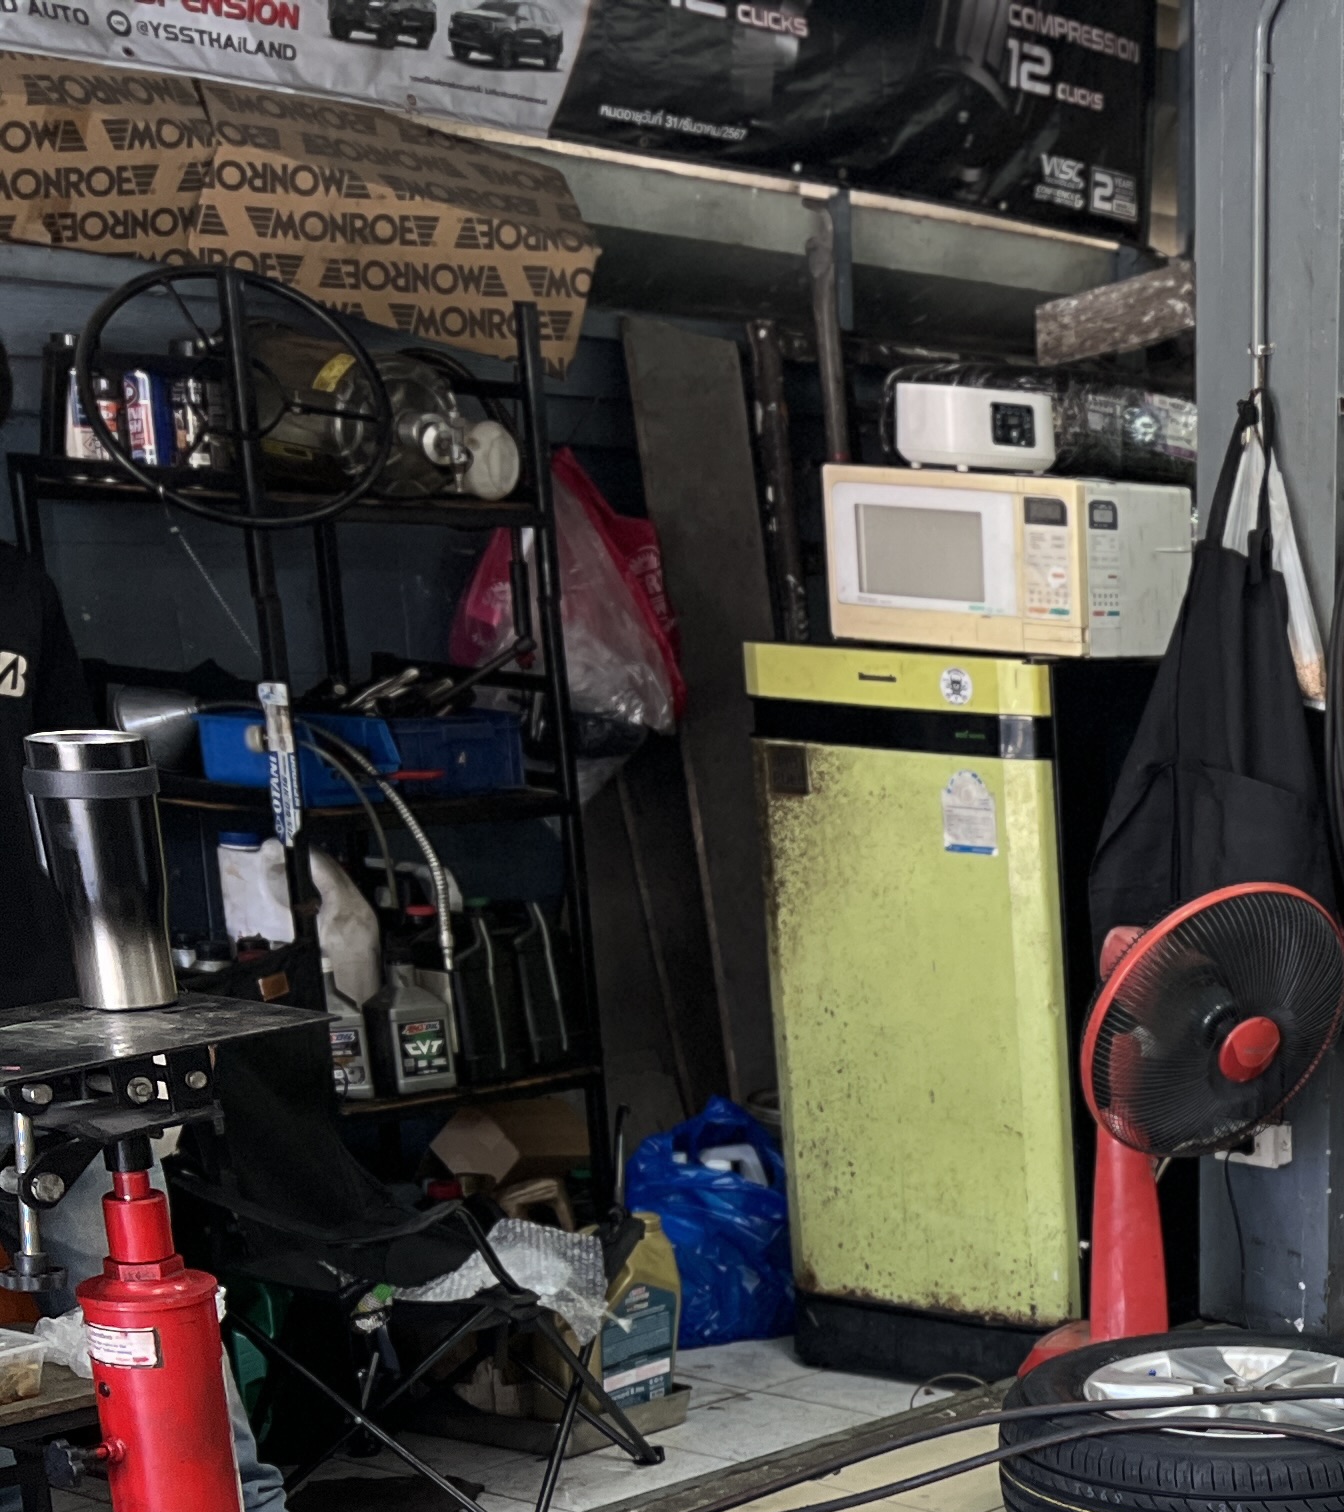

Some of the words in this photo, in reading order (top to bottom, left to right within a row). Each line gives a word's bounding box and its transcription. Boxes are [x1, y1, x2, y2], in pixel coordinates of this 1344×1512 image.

[28, 1, 90, 26] AUTO
[737, 4, 809, 38] CLICKS
[1008, 3, 1140, 64] COMPRESSION
[1007, 37, 1053, 96] 12
[1056, 82, 1104, 110] CLICKS
[1093, 171, 1114, 211] 2
[270, 208, 414, 247] MONROE
[481, 216, 588, 253] ONROE
[346, 258, 486, 297] MONROE
[268, 754, 284, 815] OTANI
[404, 1039, 443, 1056] CVT
